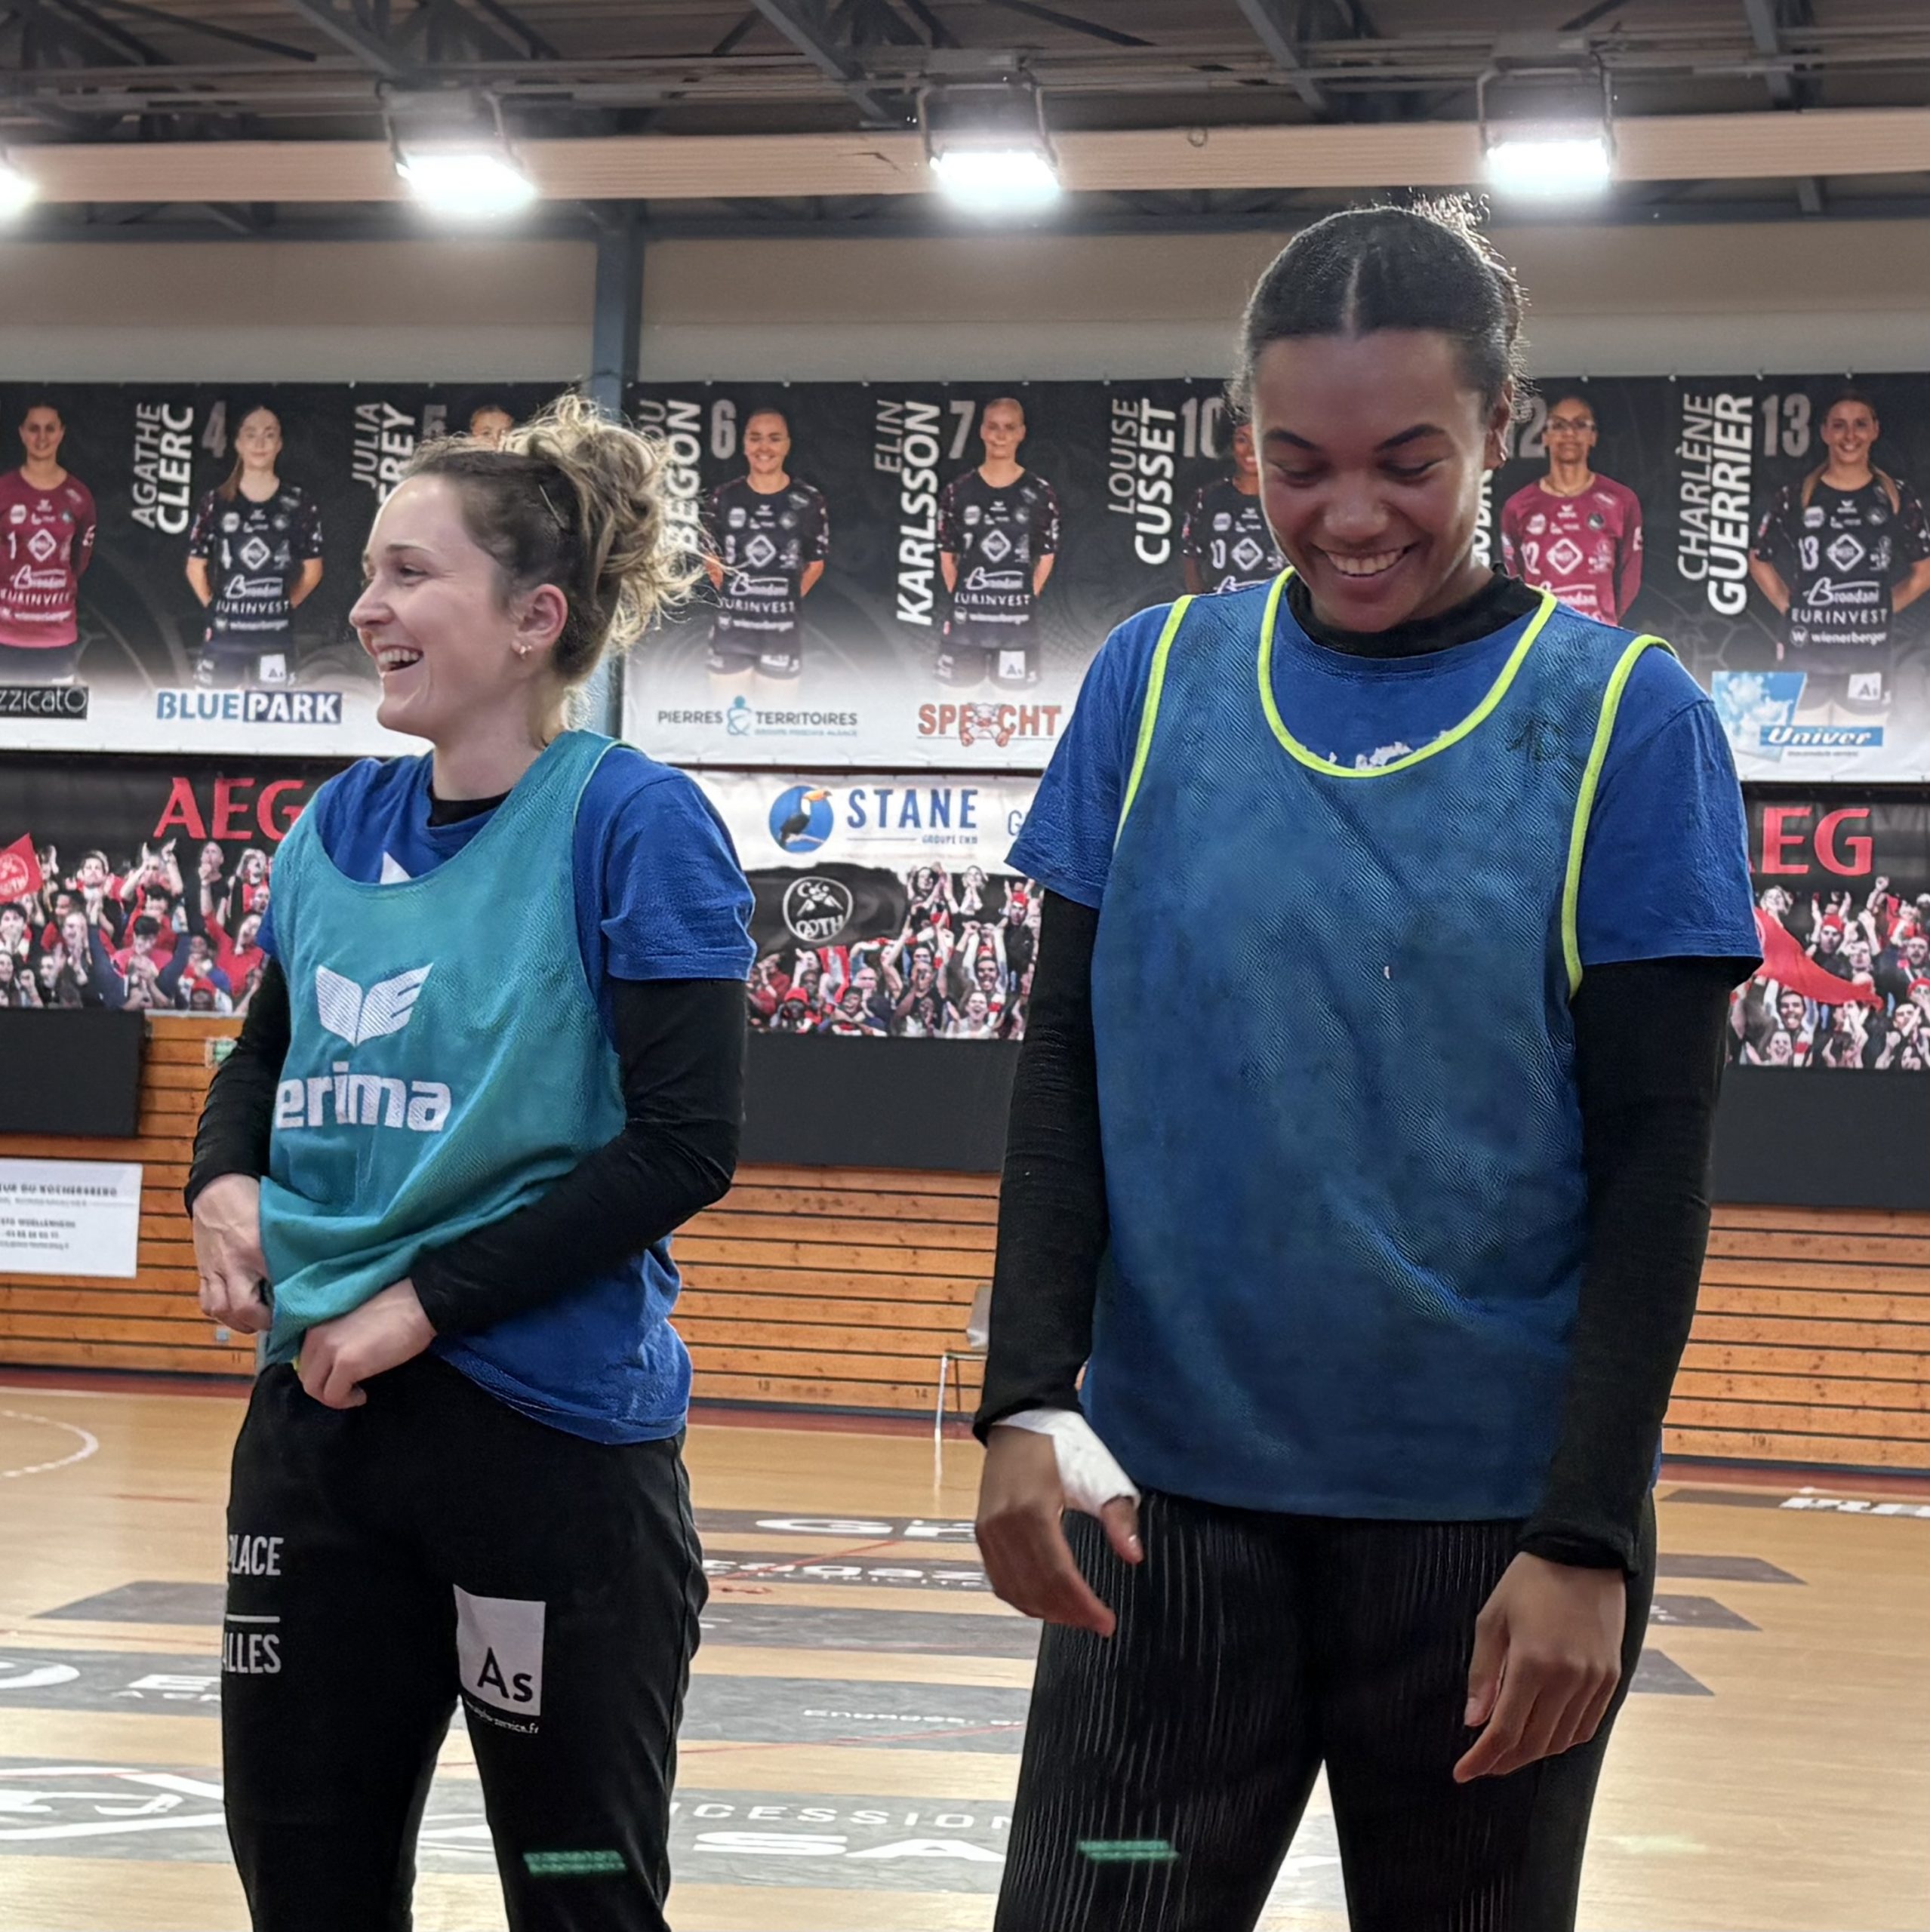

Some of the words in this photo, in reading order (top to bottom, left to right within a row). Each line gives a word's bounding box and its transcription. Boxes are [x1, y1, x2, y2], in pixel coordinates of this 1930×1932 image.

[202, 401, 226, 458] 4
[352, 403, 380, 490] JULIA
[379, 401, 415, 504] REY
[639, 400, 666, 440] OU
[711, 398, 737, 460] 6
[874, 399, 903, 473] ELIN
[948, 400, 975, 459] 7
[1762, 393, 1811, 458] 13
[131, 403, 161, 529] AGATHE
[157, 403, 194, 534] CLERC
[664, 400, 701, 555] BEGON
[1107, 398, 1138, 515] LOUISE
[1134, 398, 1176, 565] CUSSET
[1675, 393, 1713, 580] CHARLÈNE
[896, 401, 940, 626] KARLSSON
[1707, 393, 1753, 616] GUERRIER
[1791, 608, 1887, 626] EURINVEST
[658, 711, 723, 724] PIERRES
[756, 711, 857, 726] TERRITOIRES
[1767, 728, 1872, 745] Univer
[152, 777, 305, 841] AEG
[847, 789, 978, 829] STANE
[1750, 807, 1873, 875] EG
[275, 1061, 451, 1132] erima
[477, 1646, 534, 1703] As
